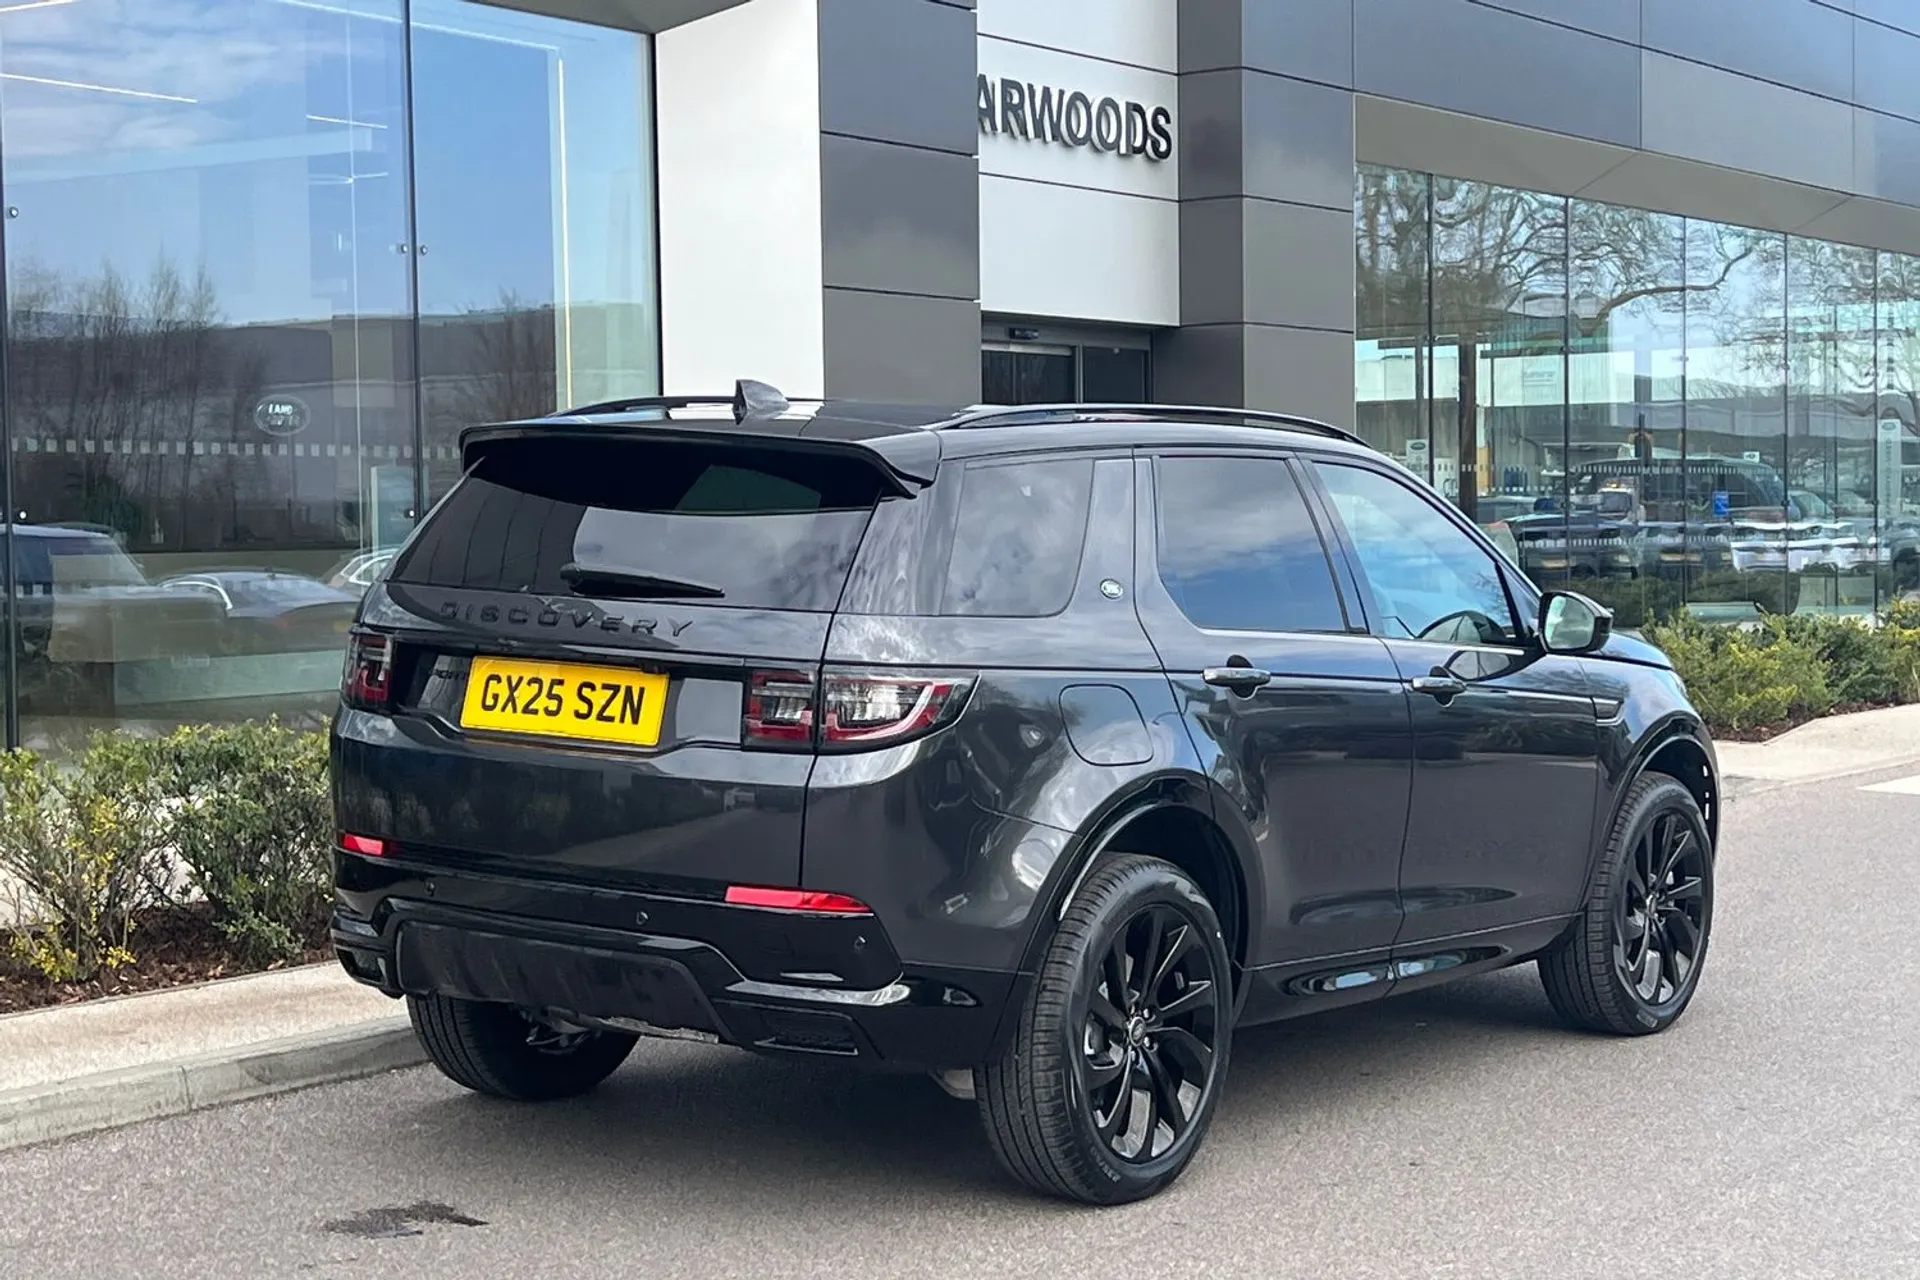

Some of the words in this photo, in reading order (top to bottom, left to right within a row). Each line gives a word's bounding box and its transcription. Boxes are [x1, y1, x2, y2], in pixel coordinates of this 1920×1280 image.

[977, 73, 1172, 160] ARWOODS
[440, 601, 694, 638] DISCOVERY
[480, 673, 565, 717] GX25
[573, 681, 646, 725] SZN
